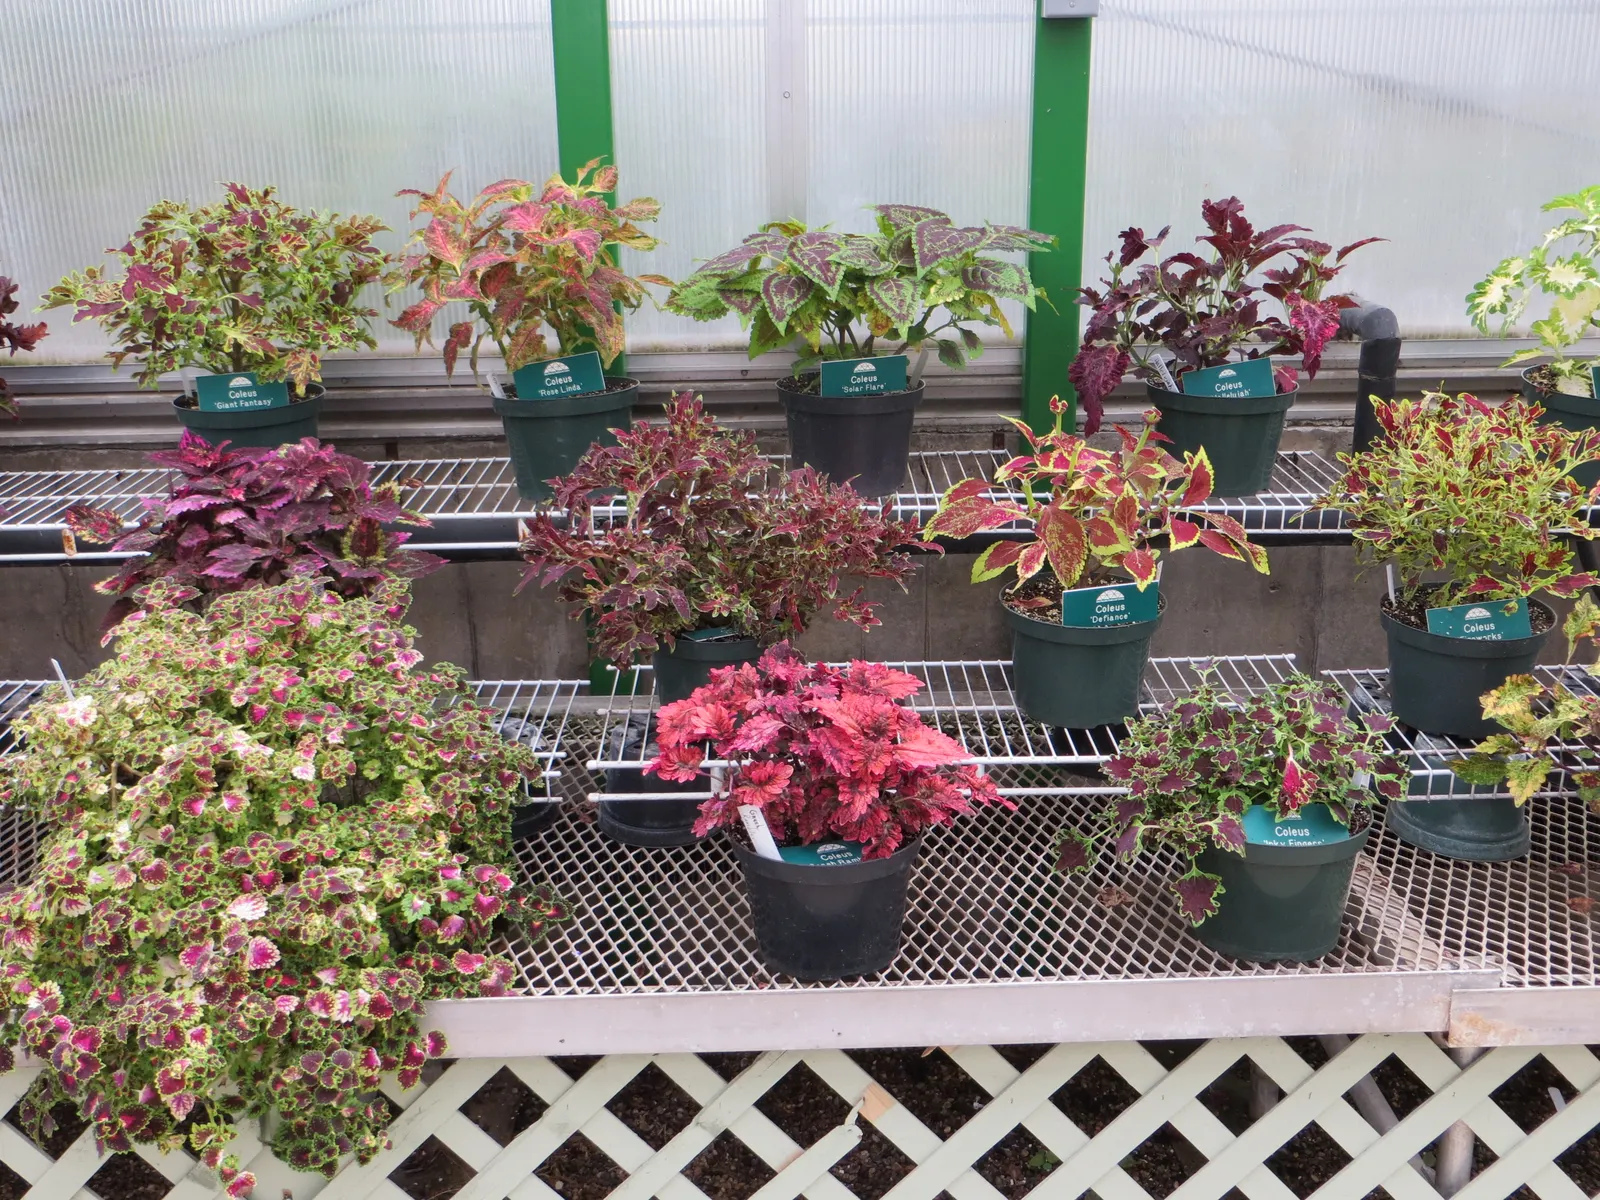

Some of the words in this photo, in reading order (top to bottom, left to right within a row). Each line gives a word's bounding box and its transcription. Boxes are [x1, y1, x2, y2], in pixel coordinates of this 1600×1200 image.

[544, 375, 573, 387] Coleus
[850, 375, 878, 384] Coleus
[1214, 381, 1243, 392] Coleus
[228, 390, 258, 399] Coleus
[1095, 603, 1126, 614] Coleus
[1090, 611, 1131, 623] 'Defiance'
[1463, 622, 1496, 633] Coleus
[1274, 826, 1310, 837] Coleus
[820, 851, 853, 861] Coleus
